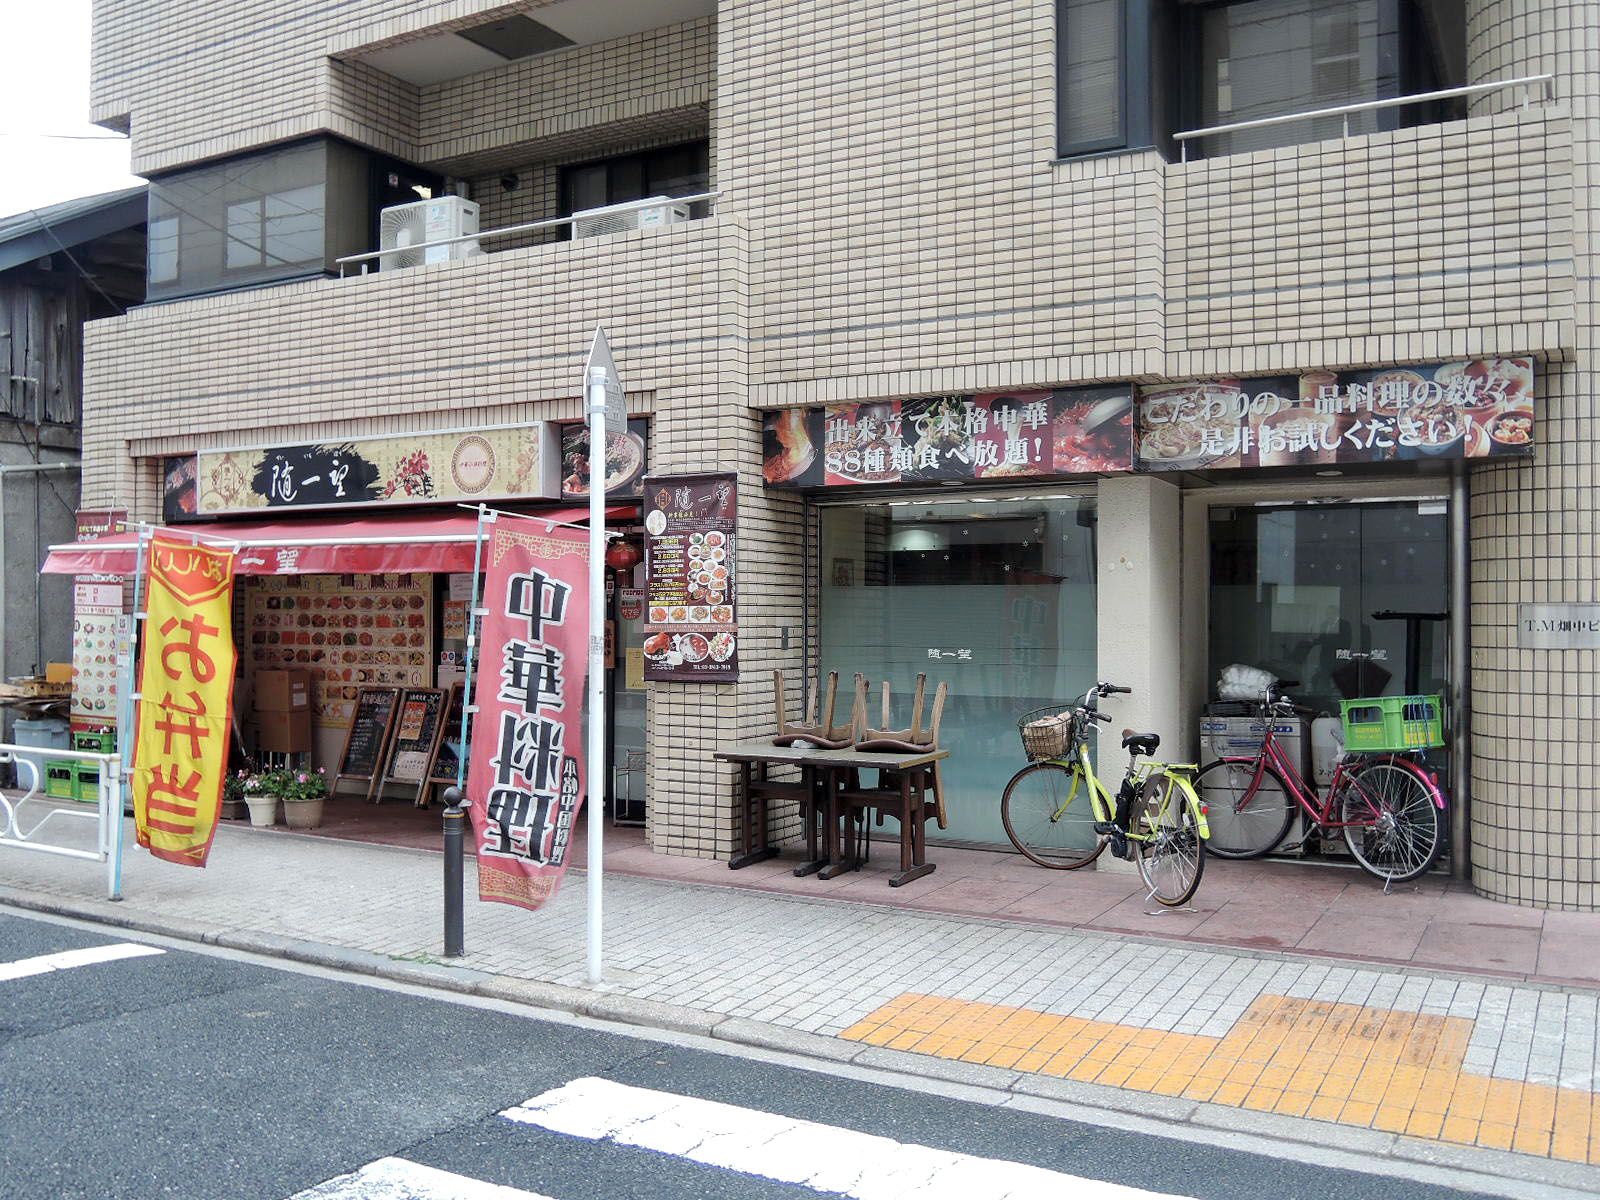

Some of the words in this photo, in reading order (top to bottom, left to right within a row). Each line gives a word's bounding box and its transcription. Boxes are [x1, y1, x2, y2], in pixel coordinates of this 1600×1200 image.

[1146, 374, 1513, 424] こだわりの一品料理の数々
[827, 401, 1048, 444] 出来立て本格中華
[826, 437, 1044, 474] 88種類食べ放題!
